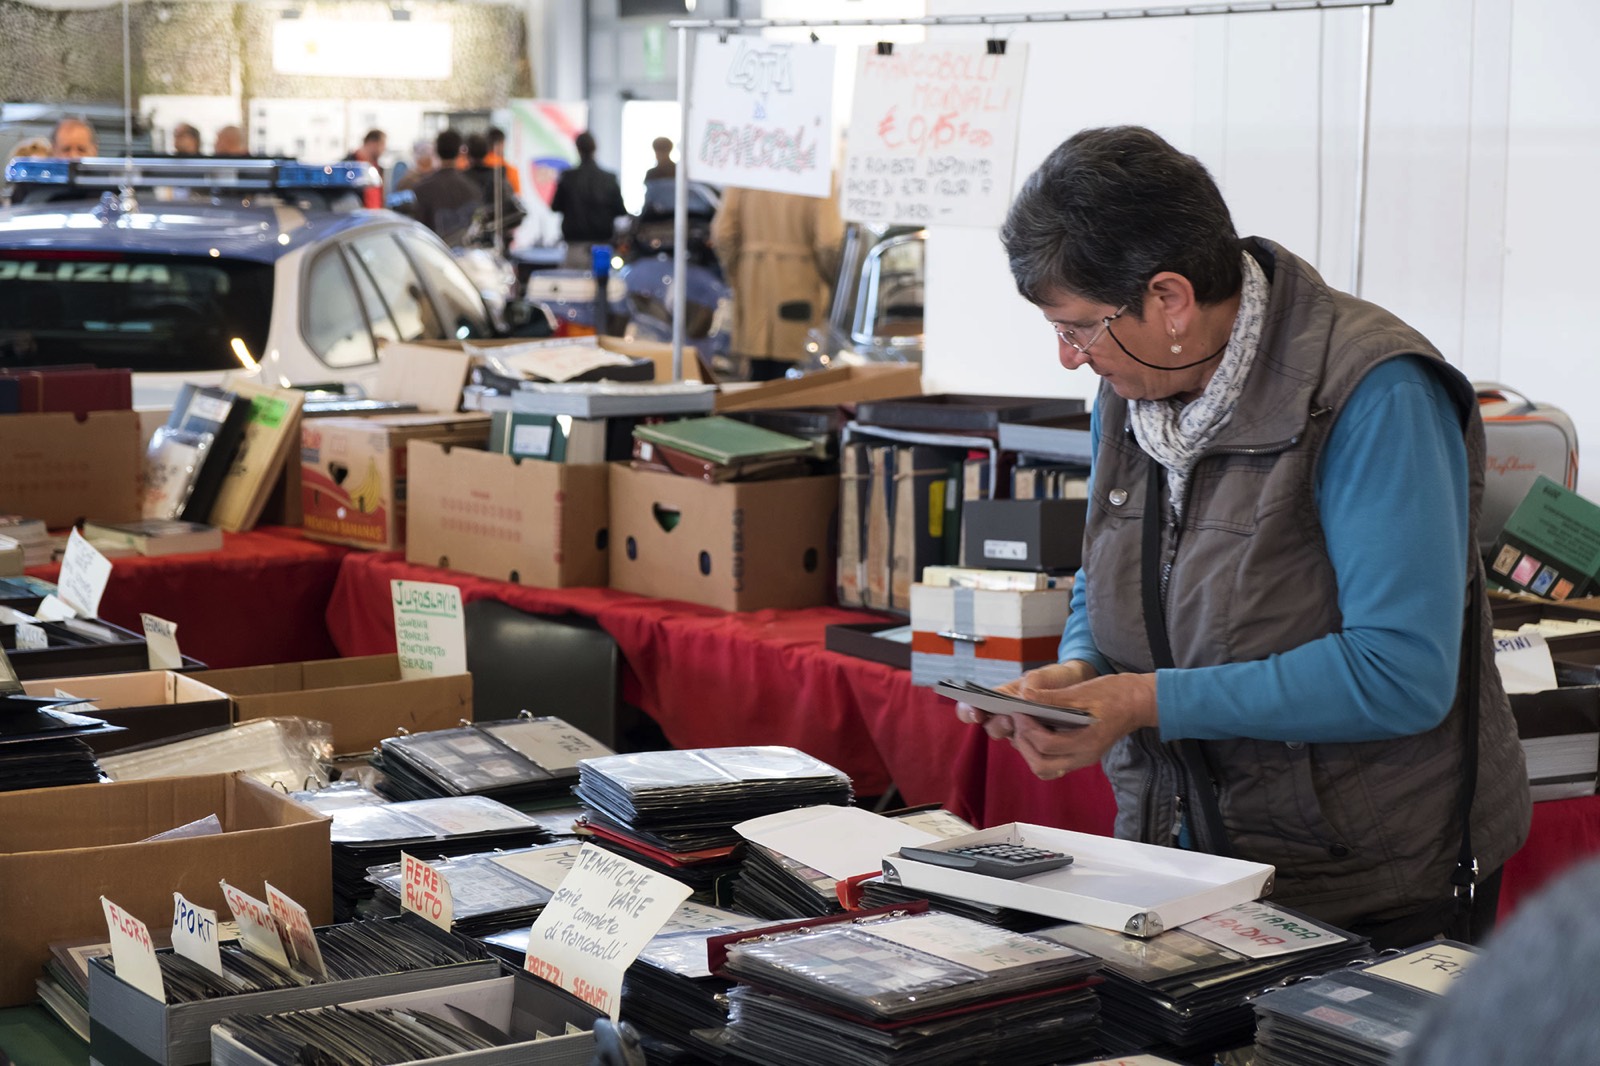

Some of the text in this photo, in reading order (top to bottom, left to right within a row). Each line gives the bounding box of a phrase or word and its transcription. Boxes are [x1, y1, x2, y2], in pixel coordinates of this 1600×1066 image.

[406, 858, 444, 895] AEREI
[578, 849, 656, 894] TEMATICHE
[227, 889, 275, 934] SPAZIO
[406, 883, 443, 920] AUTO
[554, 888, 582, 906] serie
[607, 889, 655, 919] VARIE
[109, 904, 151, 954] FLORA
[174, 898, 214, 943] SPORT
[544, 920, 562, 940] di
[573, 906, 619, 935] complete
[527, 955, 564, 987] PREZZI
